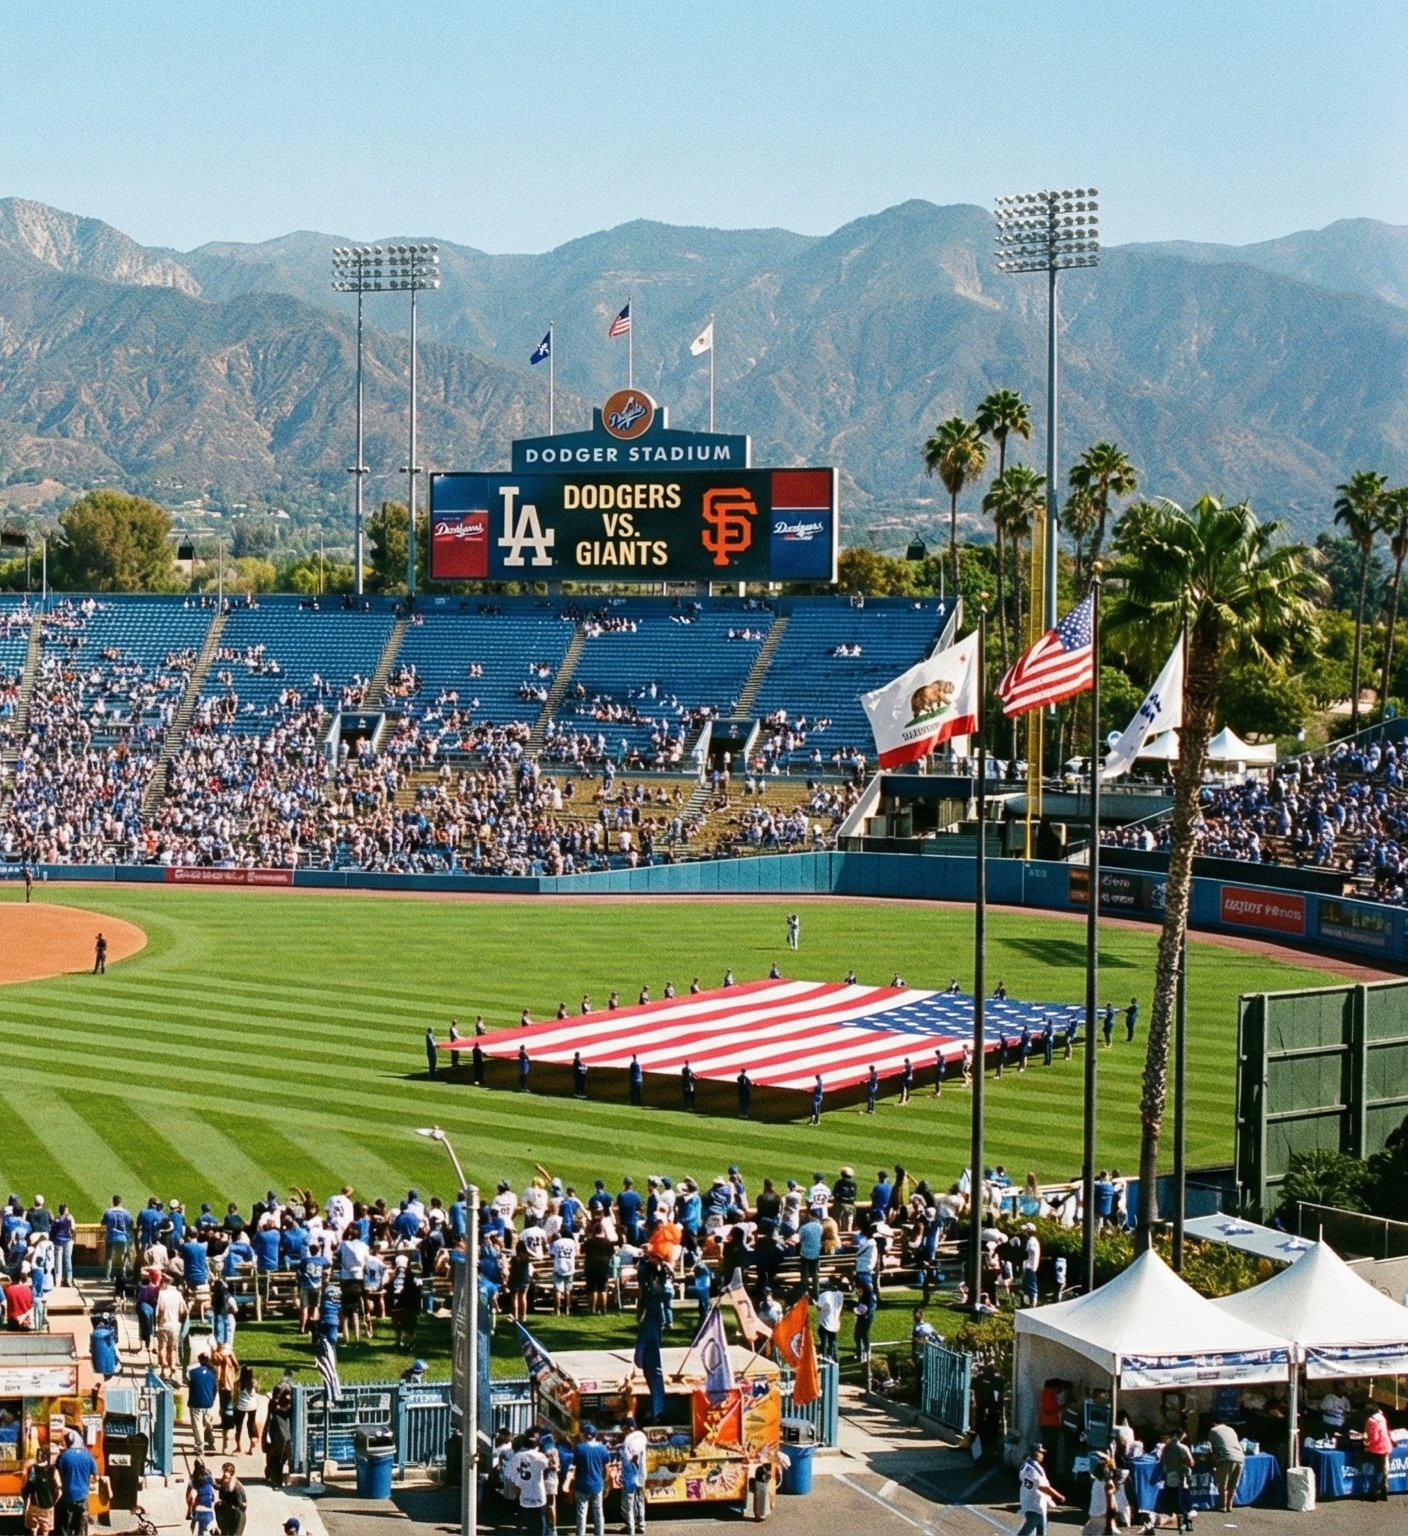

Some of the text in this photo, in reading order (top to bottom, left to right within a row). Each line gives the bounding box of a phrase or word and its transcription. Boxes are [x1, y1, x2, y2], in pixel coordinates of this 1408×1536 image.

[525, 445, 731, 463] DODGER STADIUM
[563, 483, 682, 510] DODGERS
[498, 486, 555, 566] LA
[602, 513, 641, 537] VS.
[701, 487, 759, 566] SF
[575, 540, 669, 566] GIANTS
